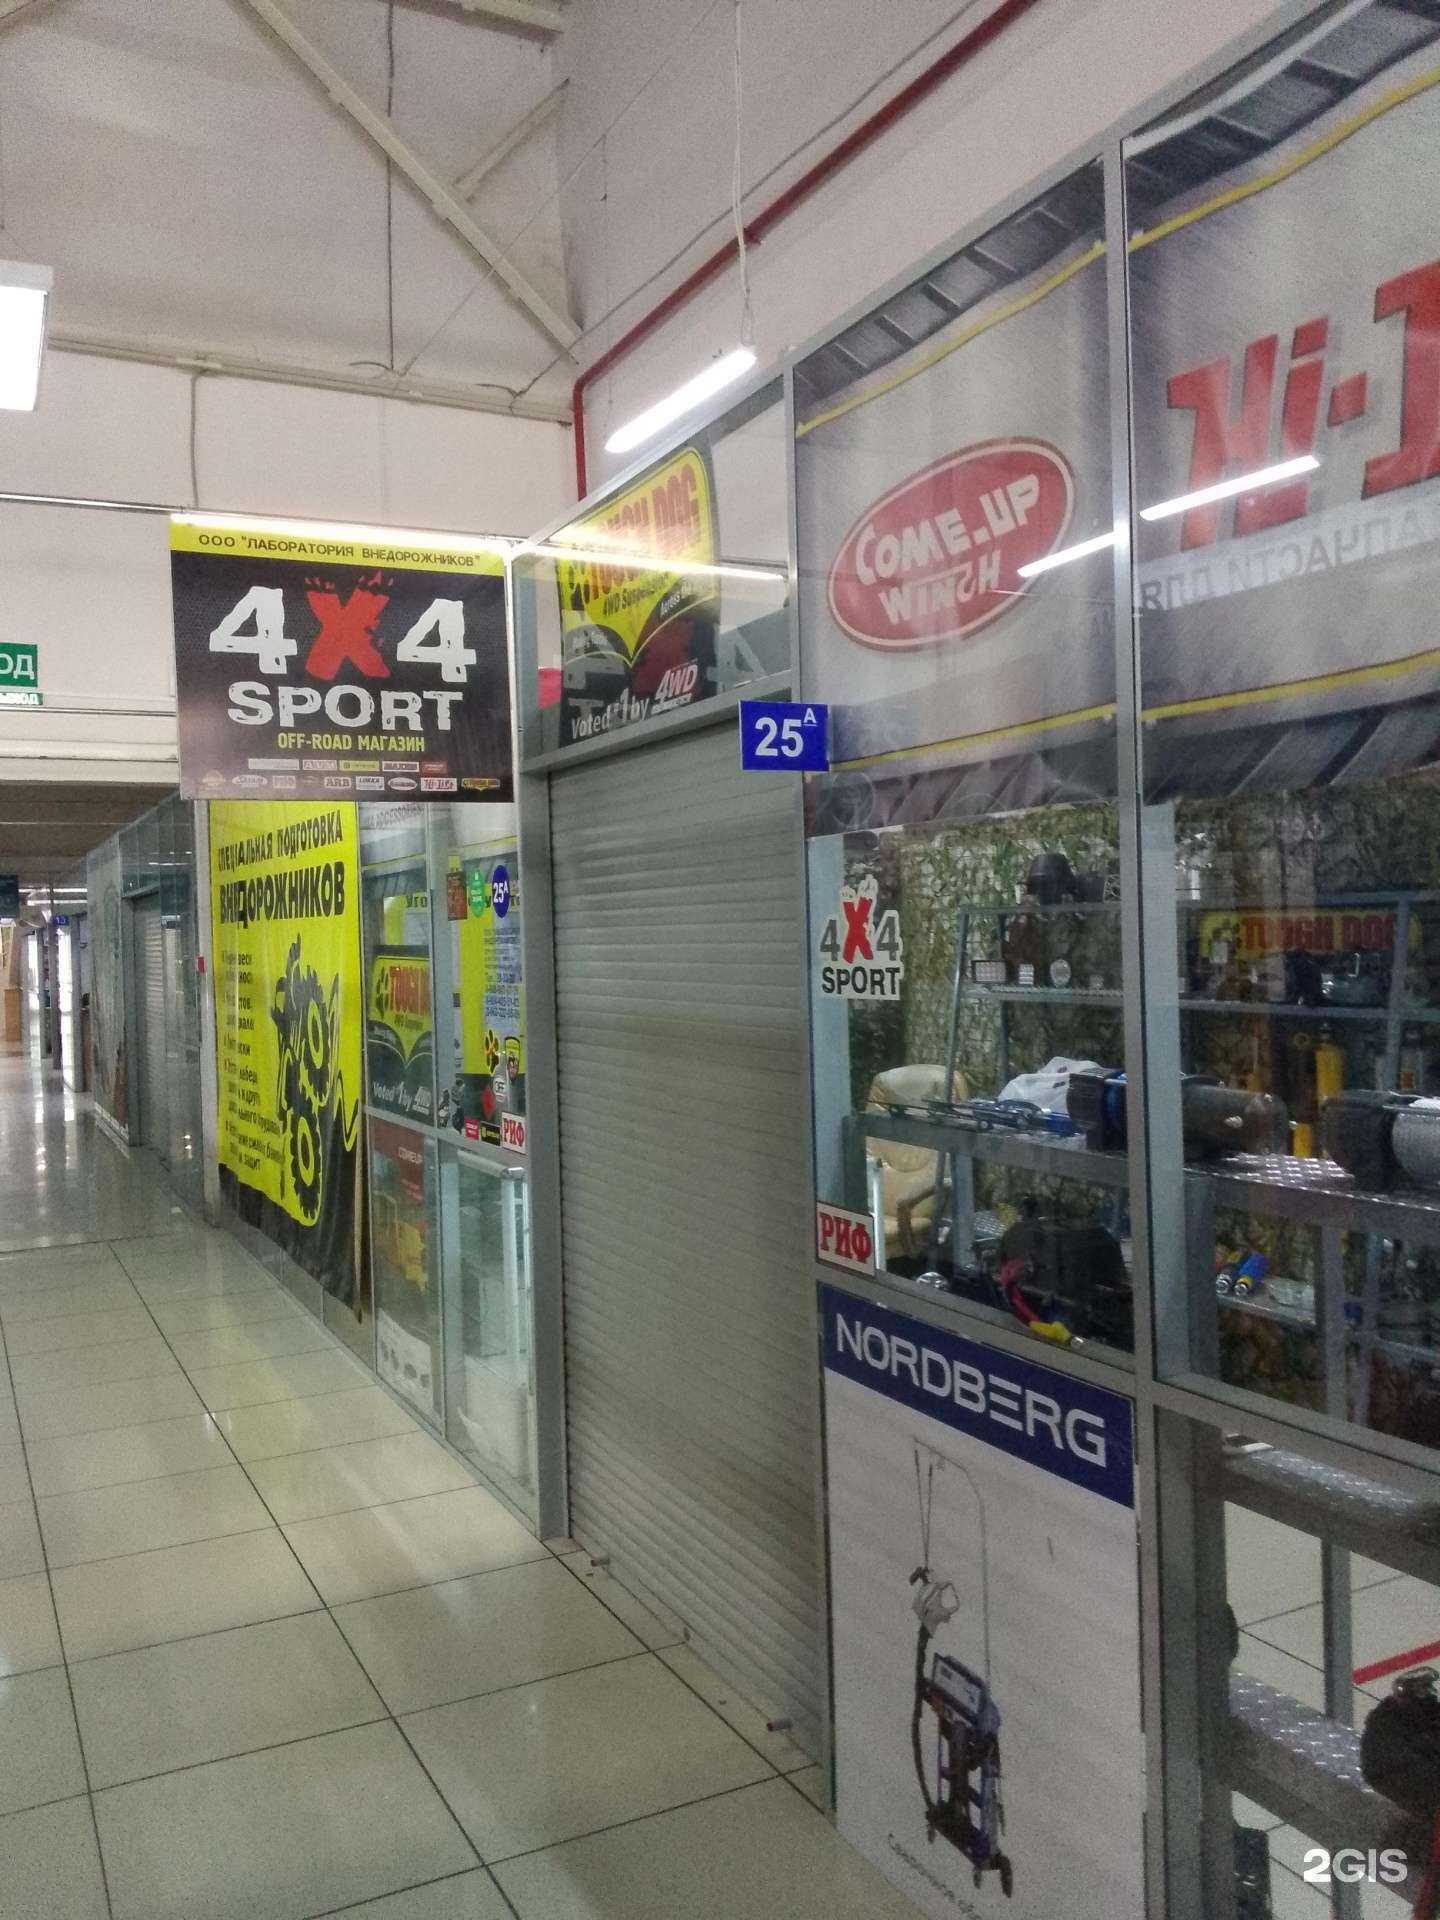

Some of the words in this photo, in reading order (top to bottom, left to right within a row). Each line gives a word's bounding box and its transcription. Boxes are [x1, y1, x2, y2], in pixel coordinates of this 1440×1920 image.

[198, 534, 236, 548] ООО
[241, 536, 354, 557] "ЛАБОРАТОРИЯ
[362, 548, 481, 567] ВНЕДОРОЖНИКОВ"
[877, 551, 1001, 625] WINCH
[227, 681, 463, 731] SPORT
[571, 700, 612, 739] Voted
[630, 695, 650, 720] by
[655, 664, 698, 700] 4WD
[278, 732, 352, 751] OFF-ROAD
[358, 735, 425, 752] МАГАЗИН
[277, 810, 343, 860] ПОДГОТОВКА
[822, 965, 900, 996] SPORT
[503, 1118, 525, 1148] РИФ
[819, 1213, 872, 1264] РИФ
[836, 1313, 1107, 1468] NORDBERG
